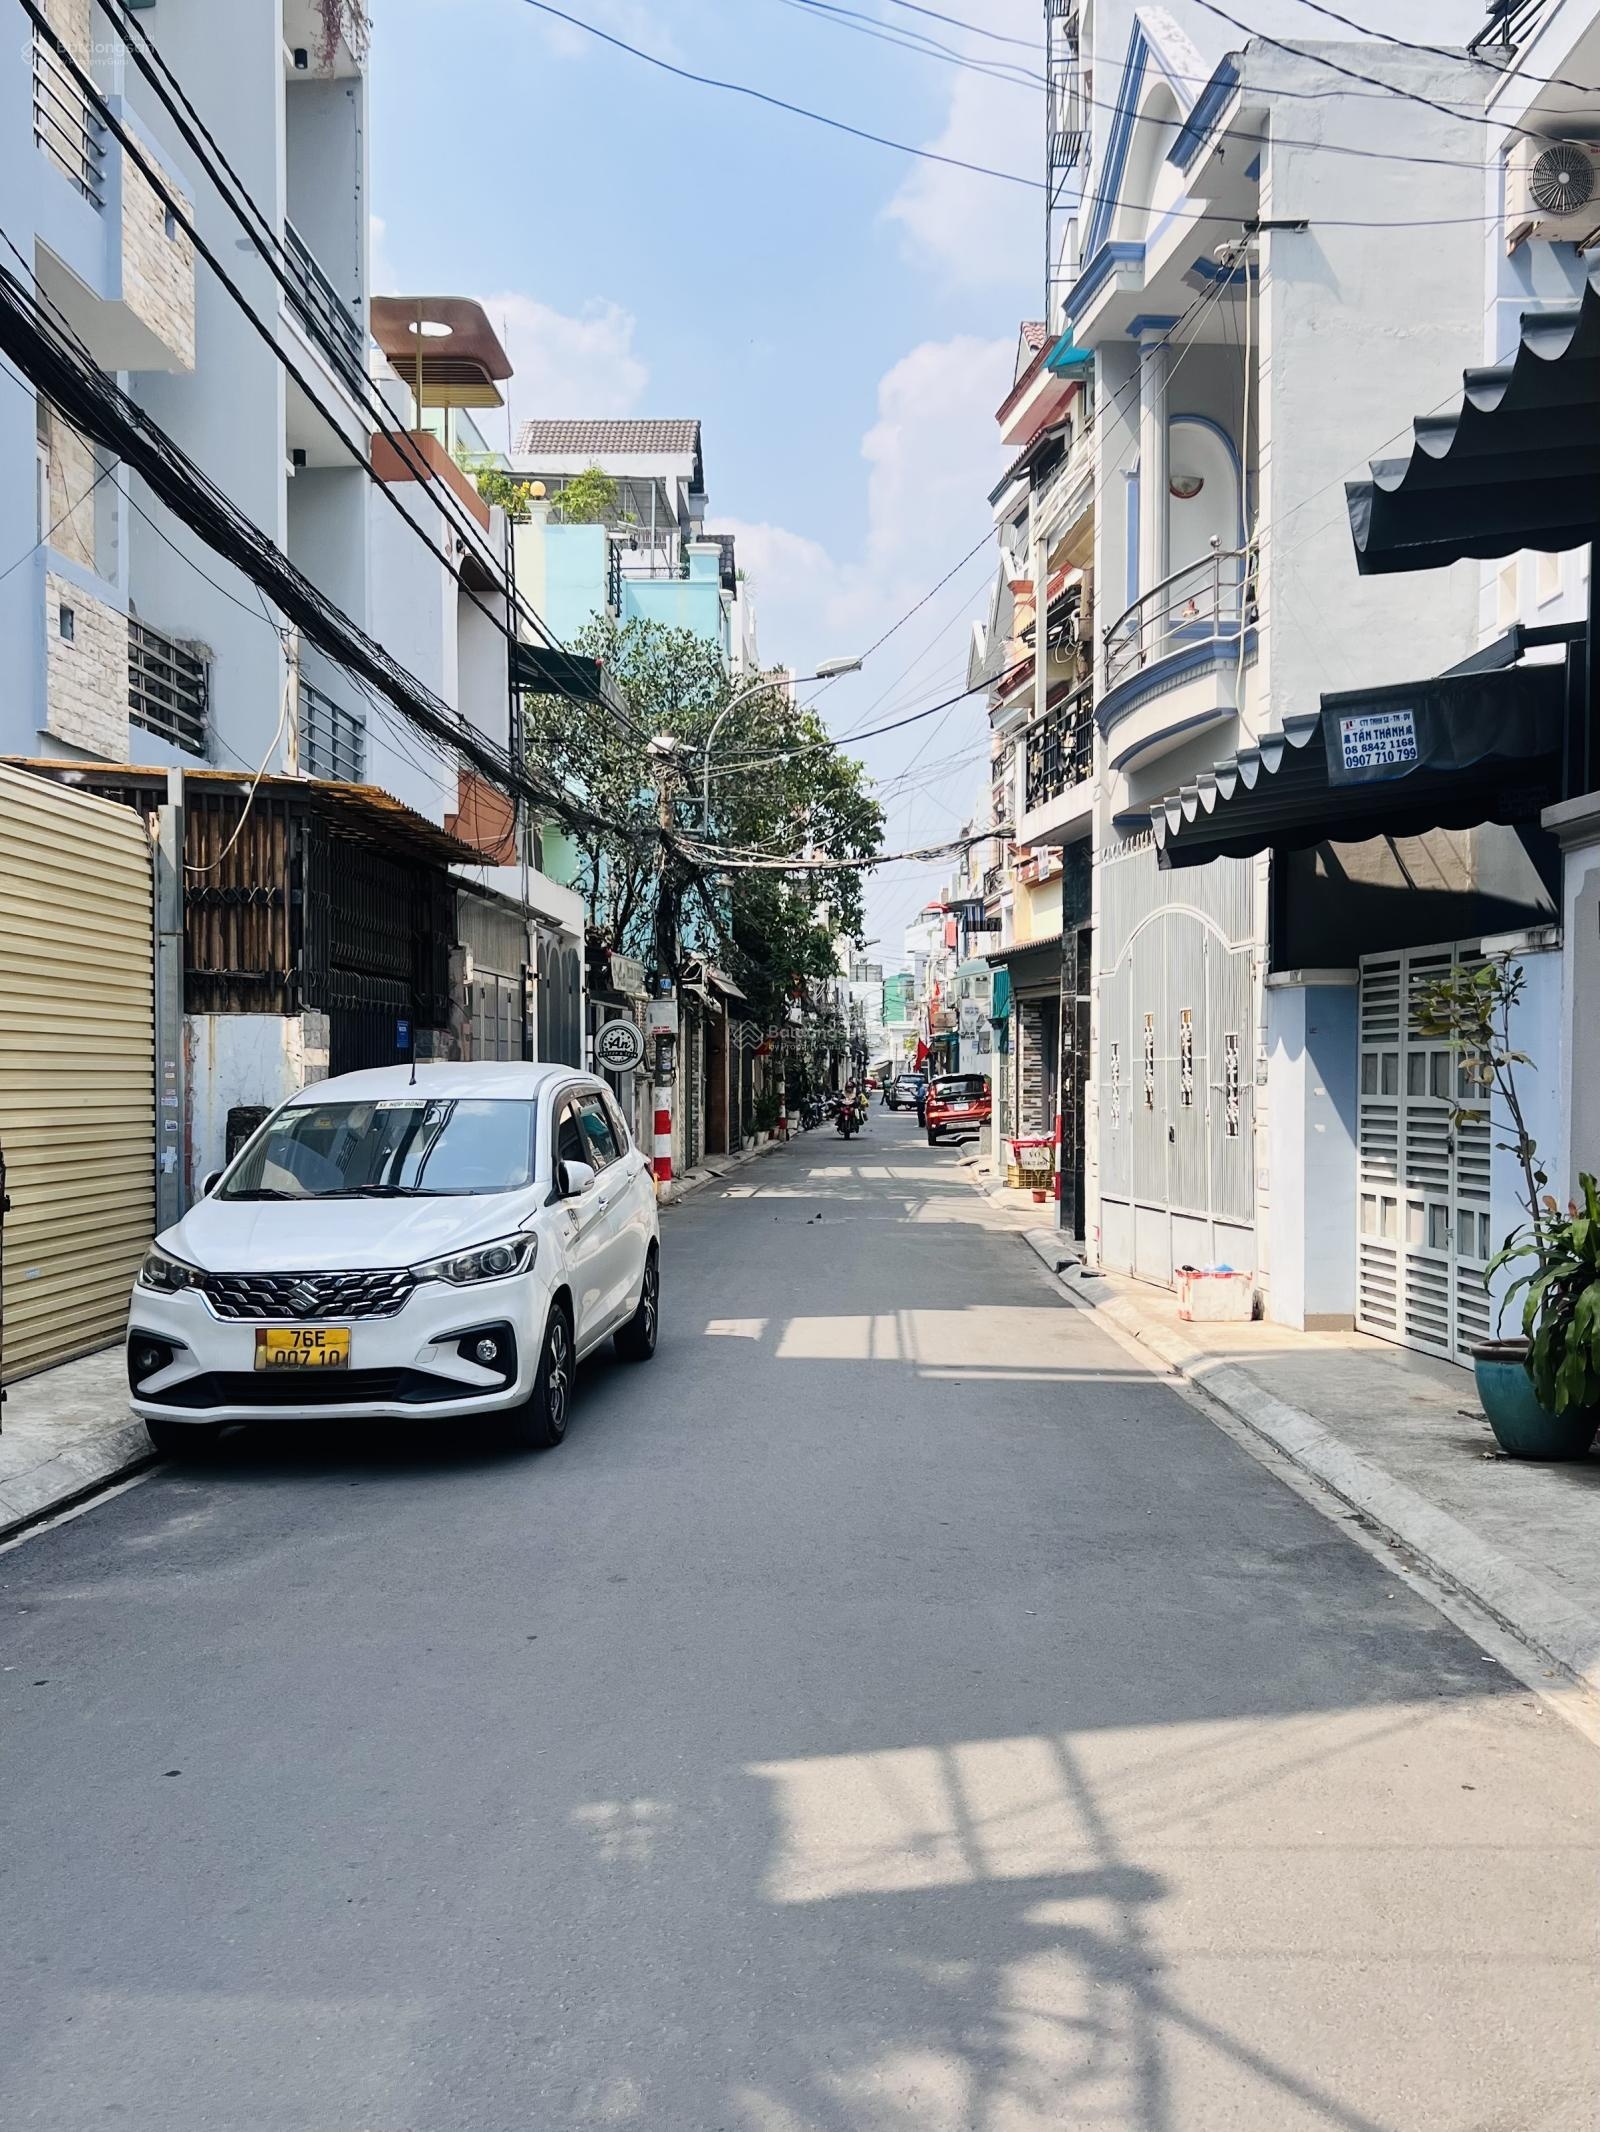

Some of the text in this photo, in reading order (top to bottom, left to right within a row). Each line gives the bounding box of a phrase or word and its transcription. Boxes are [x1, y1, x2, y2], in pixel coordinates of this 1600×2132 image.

[1344, 737, 1414, 755] 08 8842 1168
[1346, 747, 1417, 768] 0907 710 799
[608, 1036, 631, 1049] An
[290, 1330, 326, 1347] 76E
